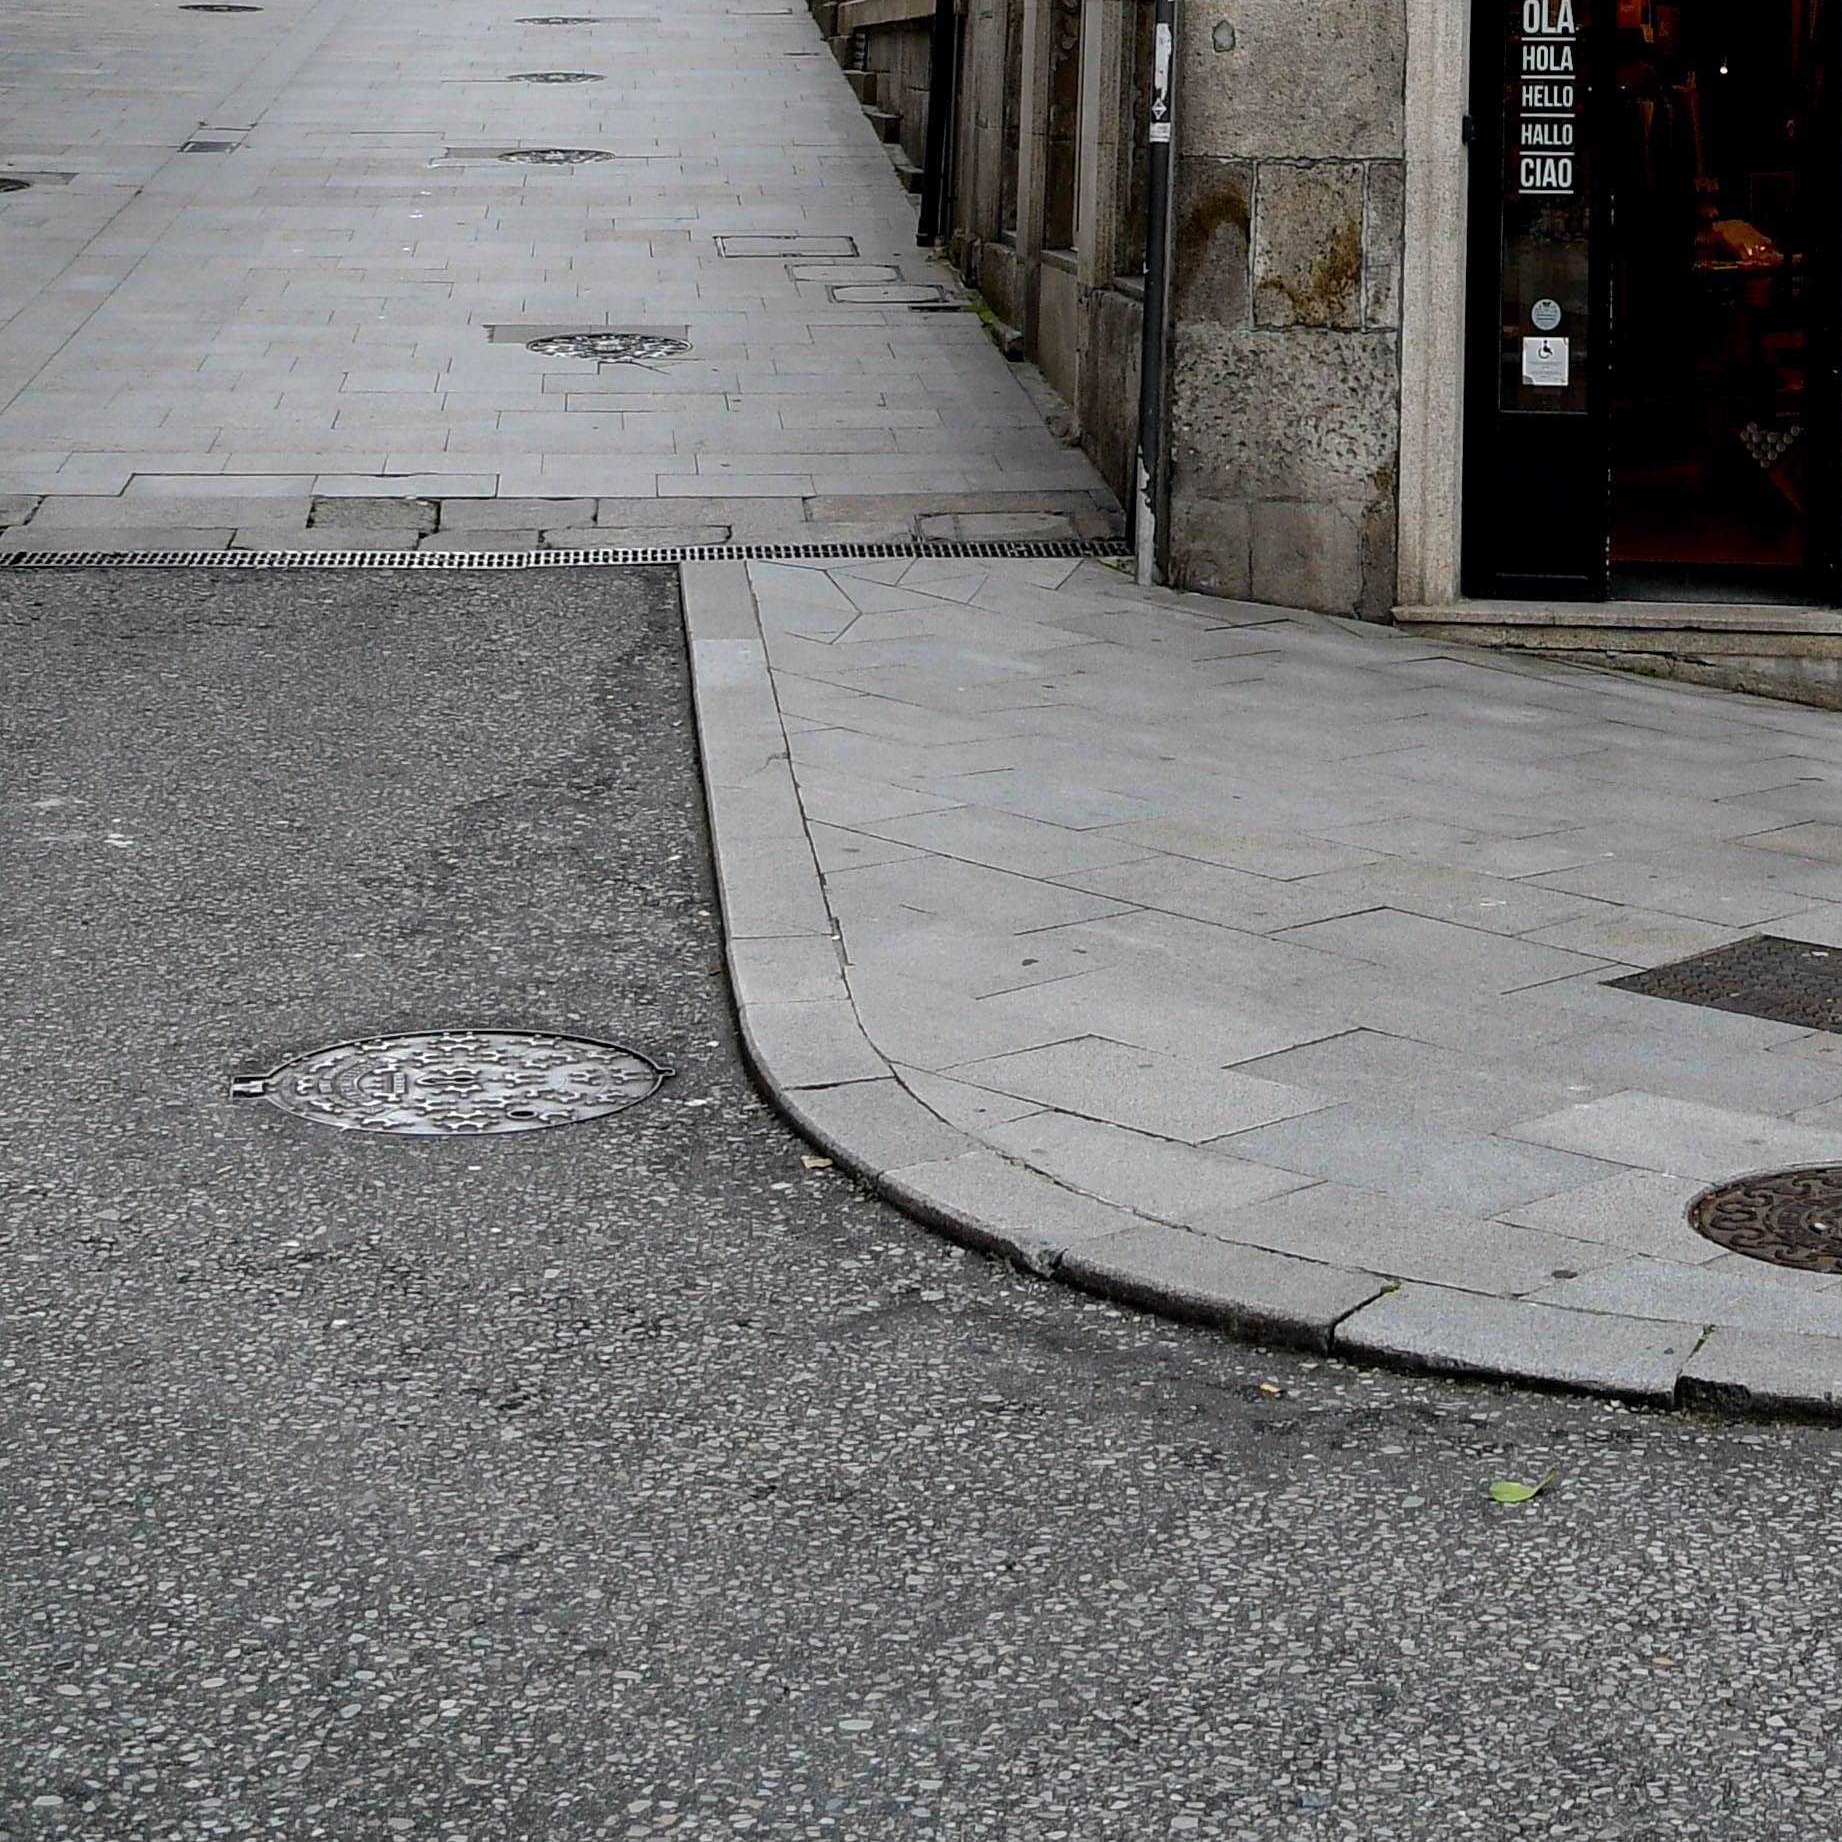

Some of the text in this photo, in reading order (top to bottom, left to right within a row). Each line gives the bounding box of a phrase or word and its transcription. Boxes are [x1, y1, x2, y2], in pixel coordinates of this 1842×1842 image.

[1522, 45, 1574, 71] HOLA
[1521, 85, 1574, 107] HELLO
[1521, 123, 1573, 146] HALLO
[1520, 158, 1572, 188] CIAO
